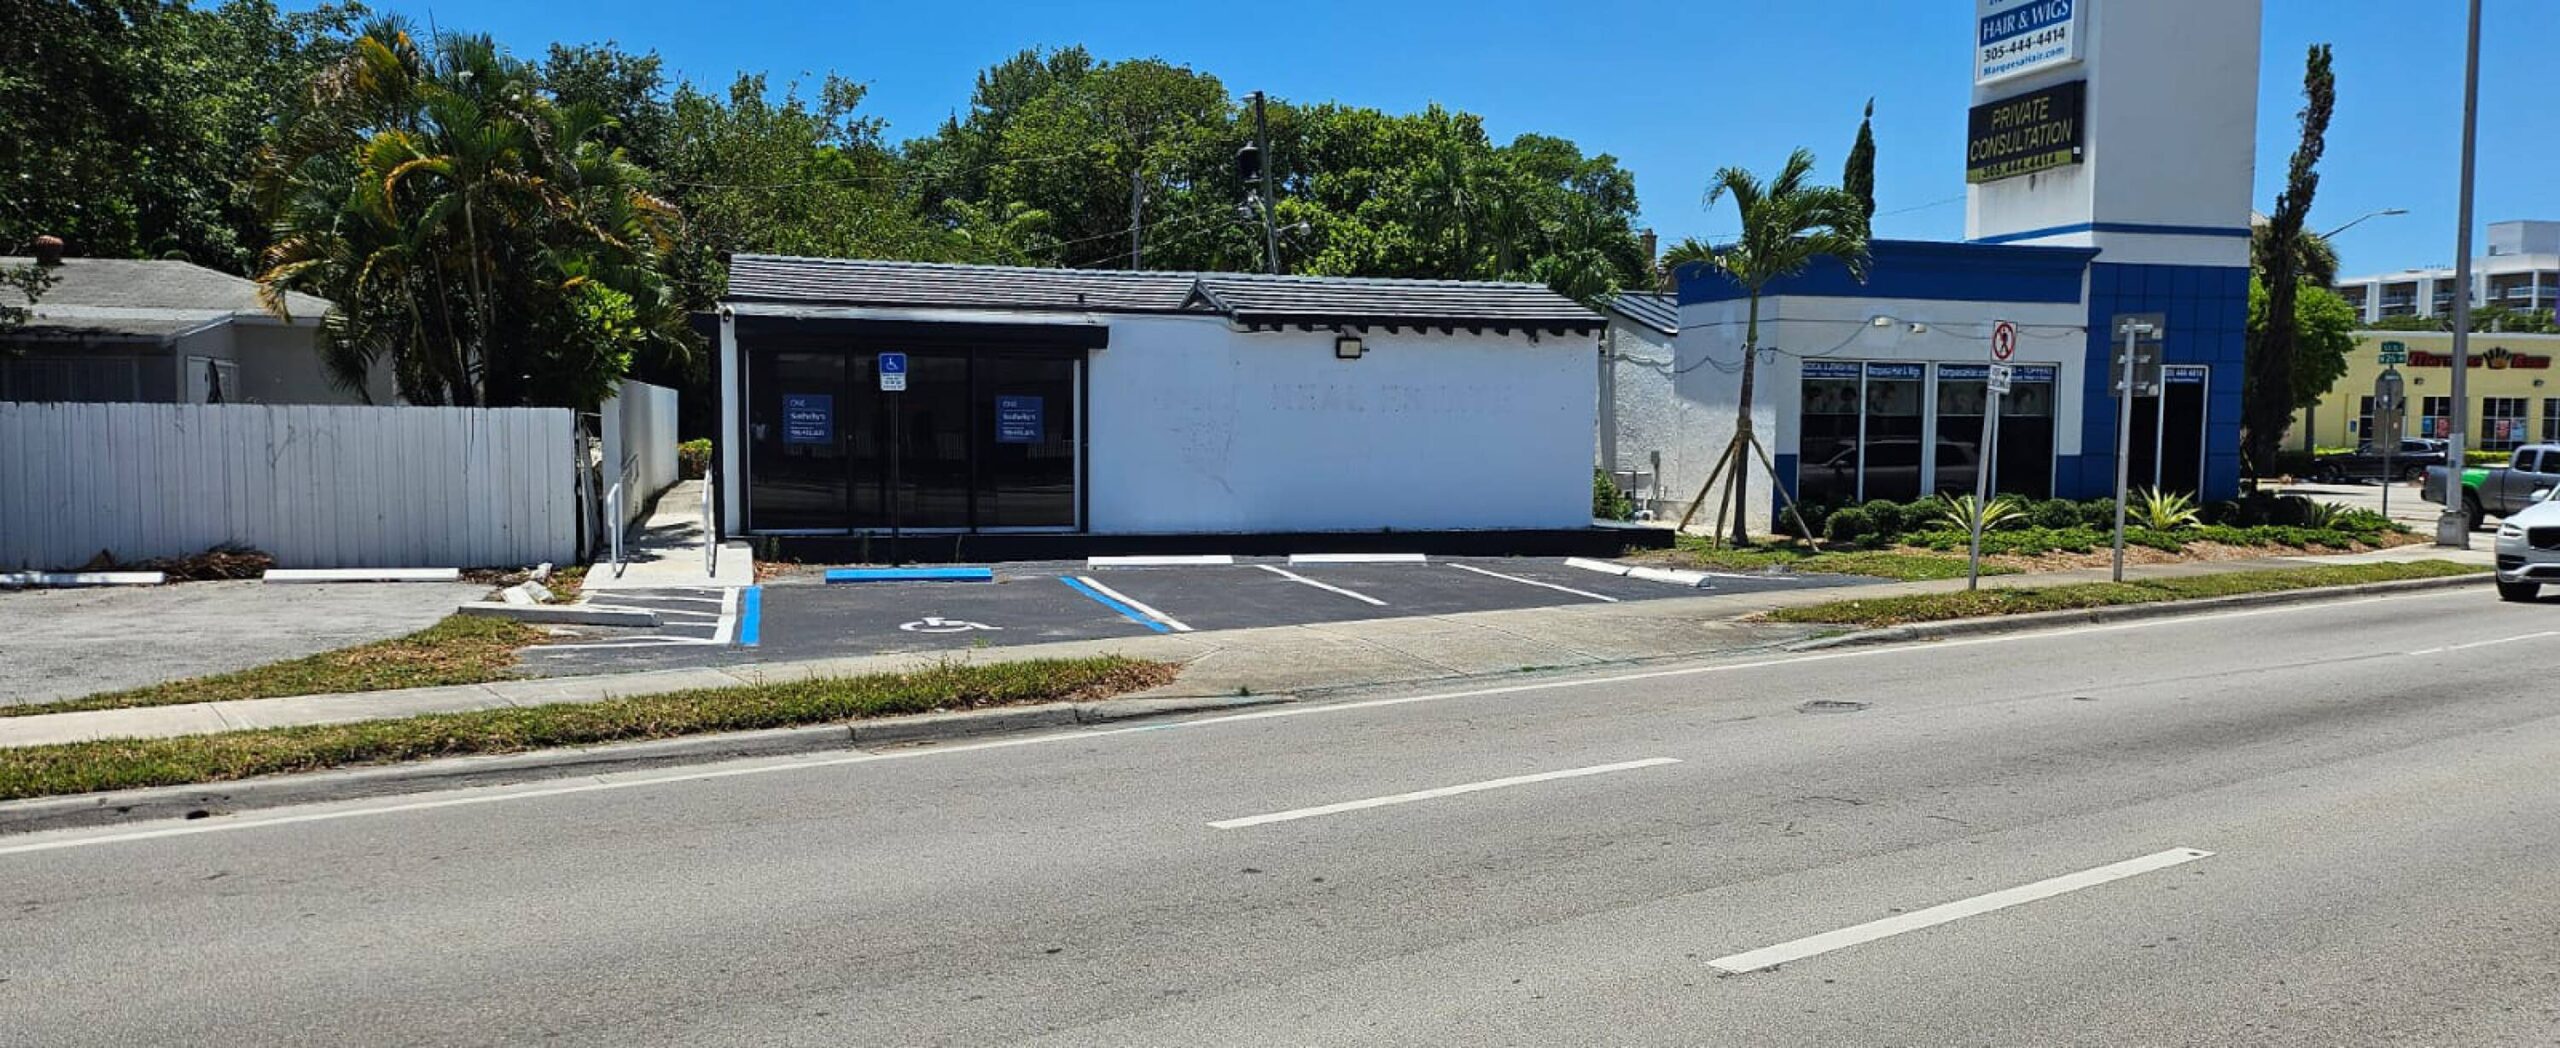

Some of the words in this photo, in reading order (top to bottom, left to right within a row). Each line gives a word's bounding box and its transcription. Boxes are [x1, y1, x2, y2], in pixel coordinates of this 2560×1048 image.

[1983, 14, 2015, 40] HAIR
[2018, 10, 2029, 29] &
[2032, 0, 2069, 24] WIGS
[1983, 26, 2065, 62] 305-444-4414
[1991, 97, 2050, 130] PRIVATE
[1970, 118, 2073, 162] CONSULTATION
